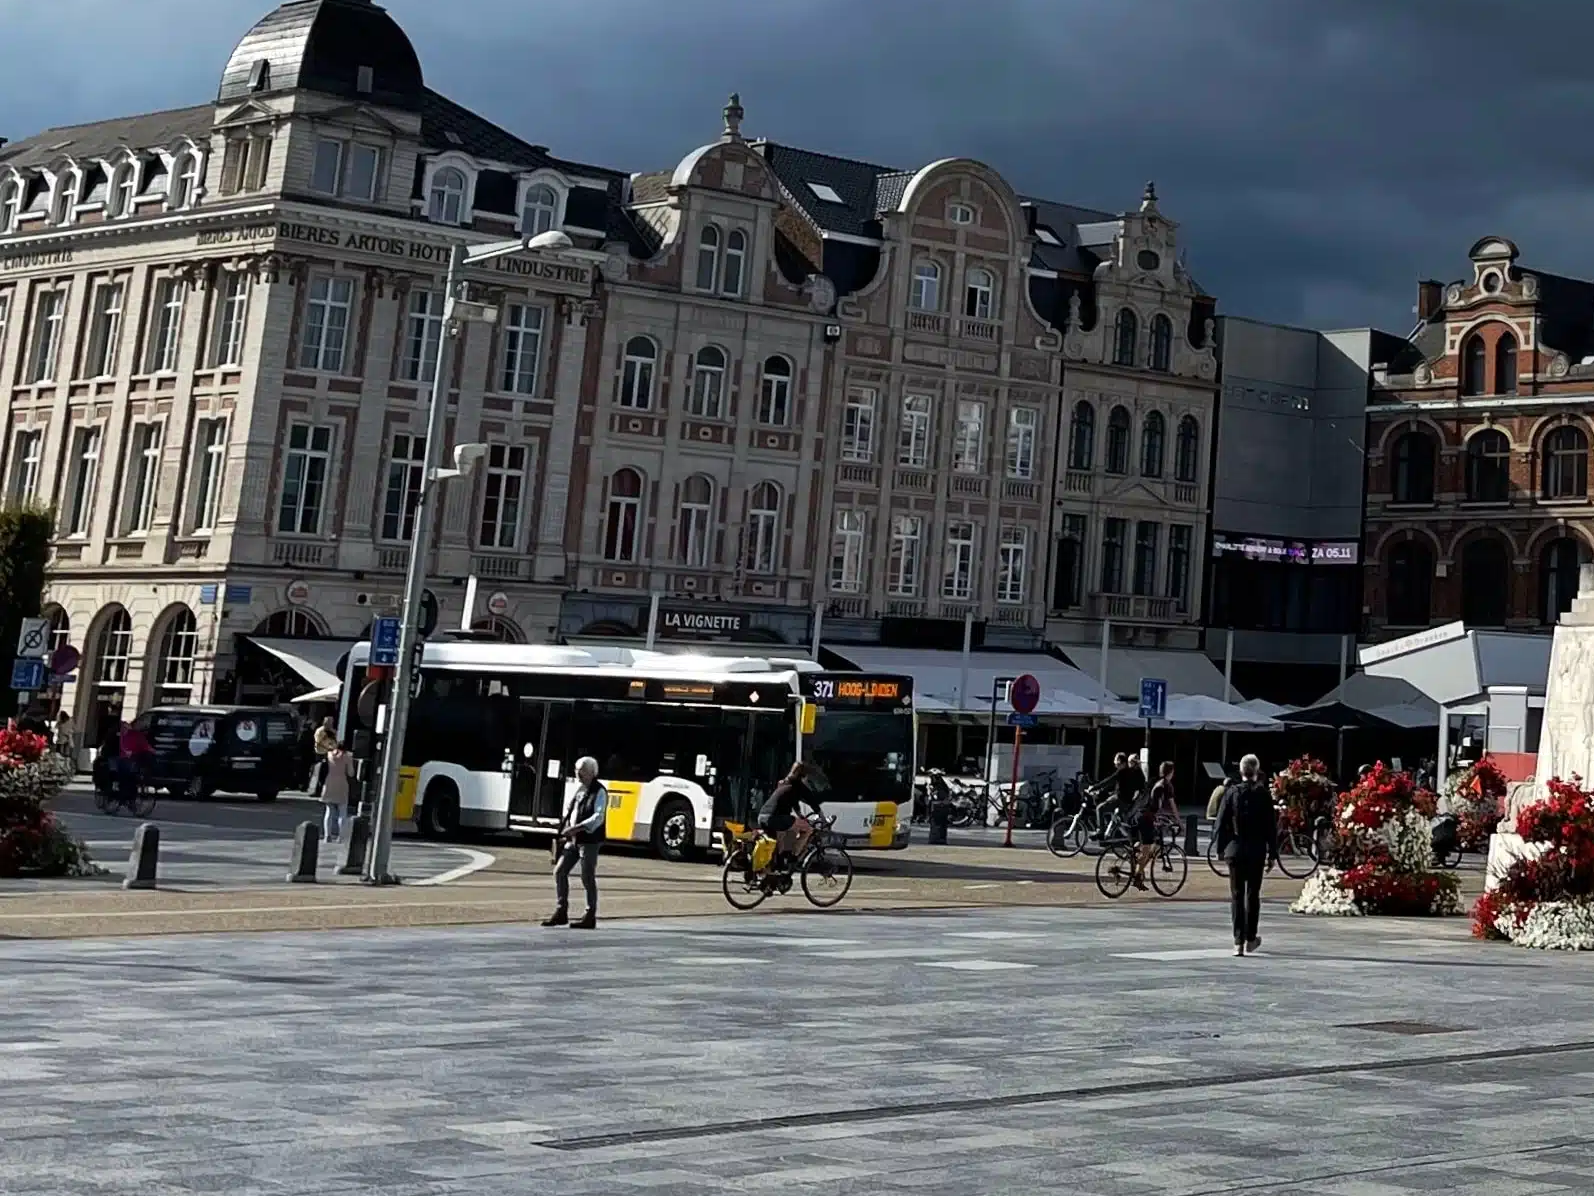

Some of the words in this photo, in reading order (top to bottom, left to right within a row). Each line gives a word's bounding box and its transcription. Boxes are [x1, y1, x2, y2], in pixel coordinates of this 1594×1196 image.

[279, 222, 339, 246] BIERES
[344, 234, 404, 255] ARTOIS
[409, 242, 453, 264] HOTE
[496, 257, 590, 284] L'INDUSTRIE
[1311, 547, 1324, 558] ZA
[665, 613, 681, 626] LA
[683, 614, 741, 630] VIGNETTE
[813, 680, 834, 698] 371
